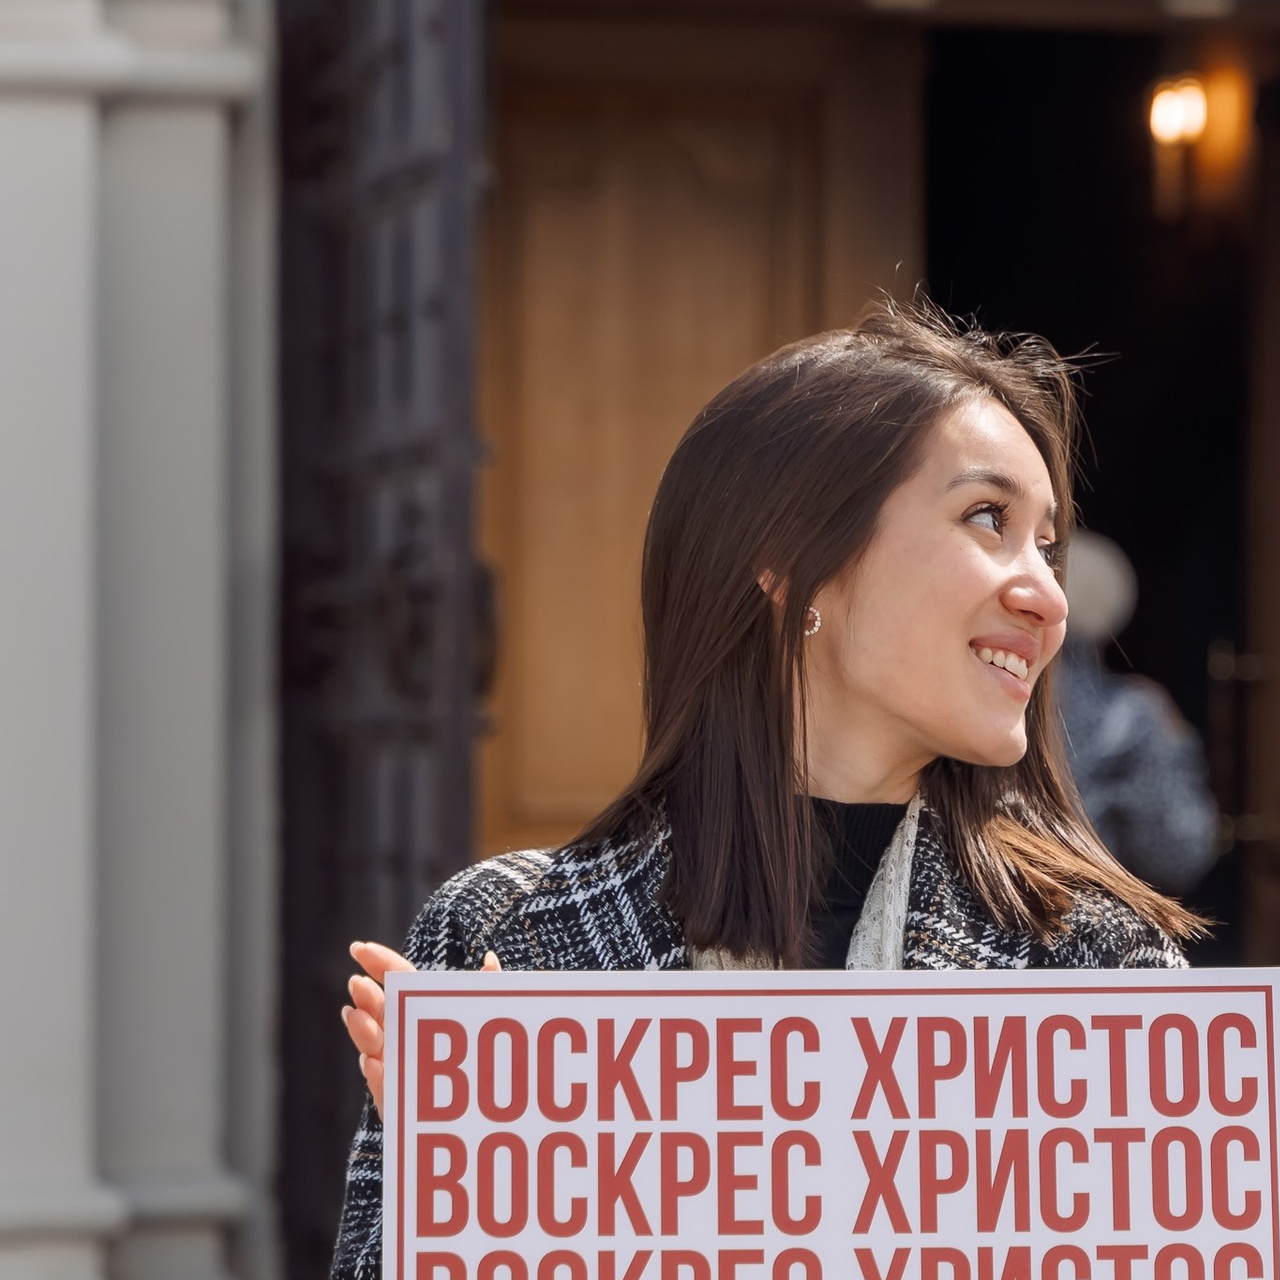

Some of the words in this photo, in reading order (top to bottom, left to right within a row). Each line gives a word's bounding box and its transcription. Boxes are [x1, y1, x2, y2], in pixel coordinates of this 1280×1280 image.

[416, 1018, 821, 1122] ВОСКРЕС
[851, 1013, 1258, 1120] ХРИСТОС
[416, 1131, 822, 1238] ВОСКРЕС
[853, 1126, 1262, 1234] ХРИСТОС
